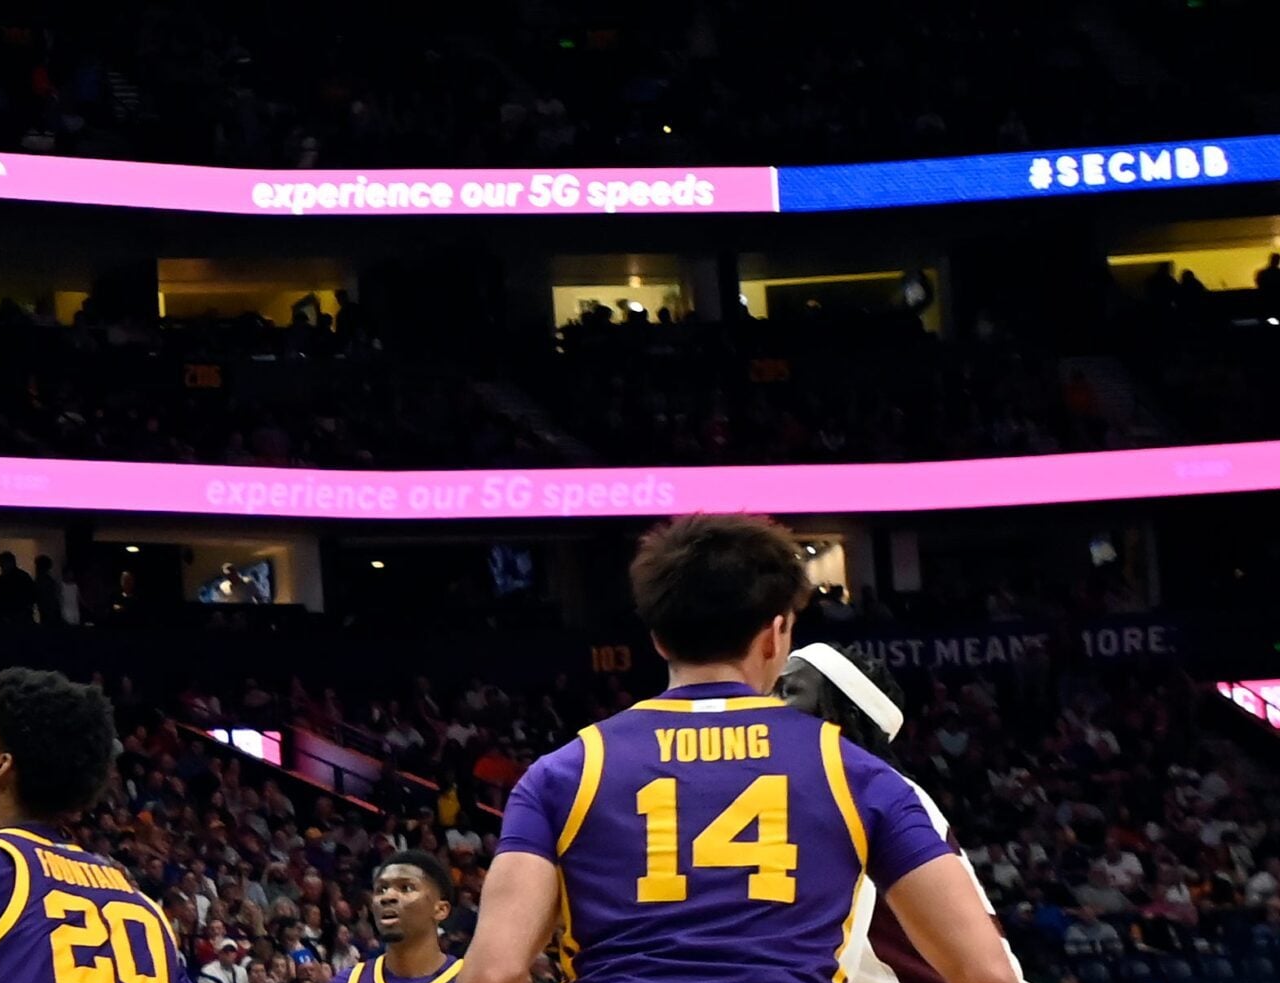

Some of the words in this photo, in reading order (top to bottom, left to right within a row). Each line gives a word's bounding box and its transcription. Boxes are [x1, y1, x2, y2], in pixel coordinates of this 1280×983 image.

[1028, 145, 1230, 191] #SECMBB
[252, 175, 454, 215] experience
[460, 181, 524, 208] our
[527, 173, 581, 208] 5G
[587, 173, 715, 213] speeds
[204, 475, 399, 514] experience
[407, 482, 473, 511] our
[480, 475, 533, 510] 5G
[542, 474, 675, 514] speeds
[655, 723, 770, 763] YOUNG
[636, 774, 798, 904] 14
